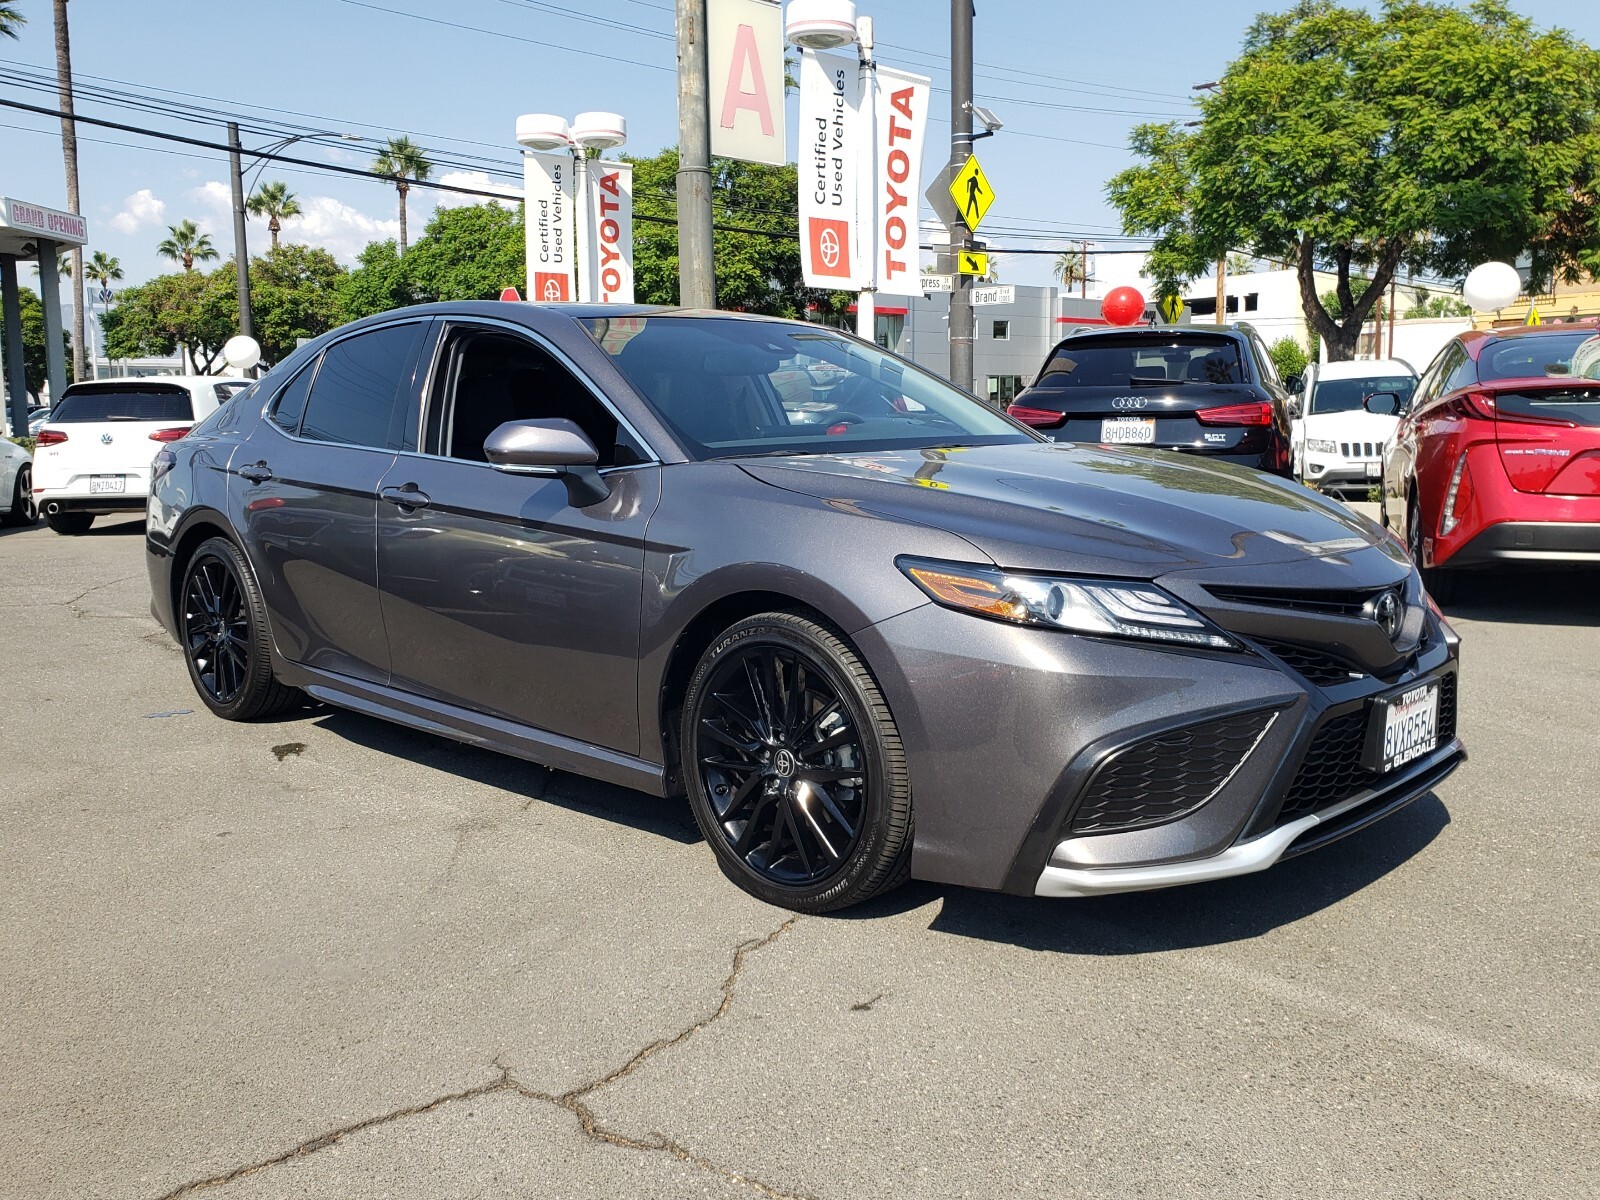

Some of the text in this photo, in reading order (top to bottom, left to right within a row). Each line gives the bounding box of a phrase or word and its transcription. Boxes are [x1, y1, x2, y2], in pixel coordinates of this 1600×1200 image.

[720, 24, 775, 137] A
[831, 69, 846, 207] Used Vehicles
[814, 117, 827, 205] Certified
[885, 86, 915, 281] TOYOTA
[12, 203, 84, 237] GRAND OPENING
[538, 199, 549, 263] Certified
[552, 164, 563, 263] Used Vehicles
[919, 278, 940, 289] press
[975, 290, 997, 303] Brand
[1105, 426, 1151, 439] 8HDB860
[709, 626, 766, 659] TURANZA
[1402, 684, 1428, 706] TOYOTA
[1385, 704, 1433, 758] 8VXR554
[1384, 736, 1437, 773] OF GLENDALE
